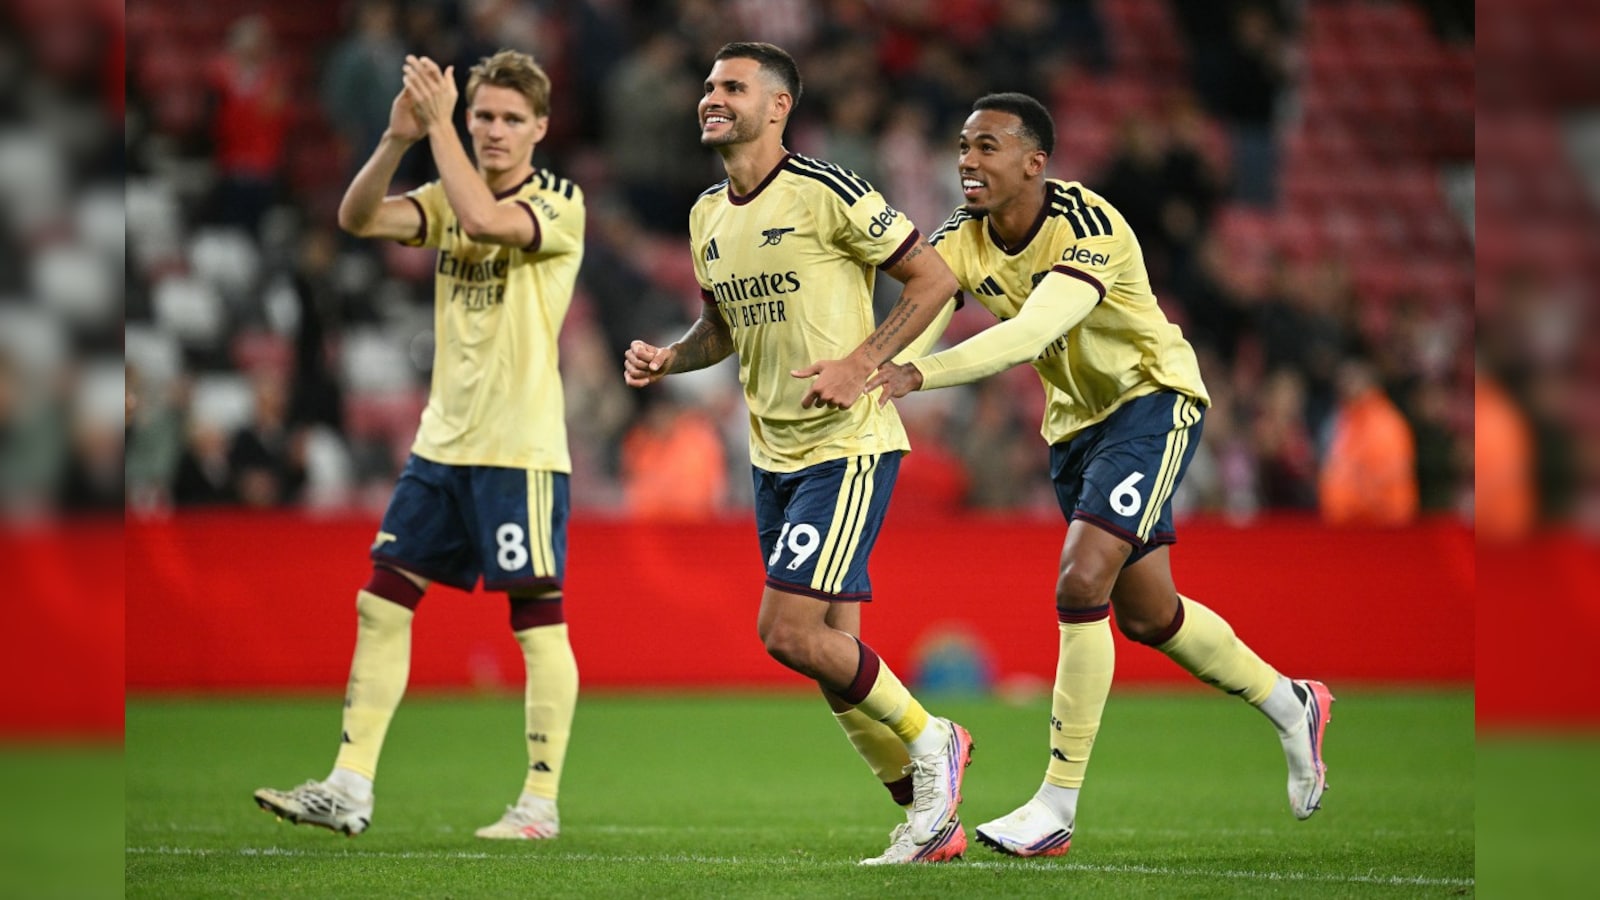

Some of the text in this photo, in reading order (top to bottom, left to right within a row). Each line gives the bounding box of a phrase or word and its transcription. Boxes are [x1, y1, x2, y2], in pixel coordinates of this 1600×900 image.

[868, 205, 898, 238] dee
[1061, 245, 1110, 267] deel
[709, 271, 800, 303] mirates
[742, 300, 786, 327] BETTER
[1109, 471, 1145, 517] 6
[496, 522, 529, 571] 8
